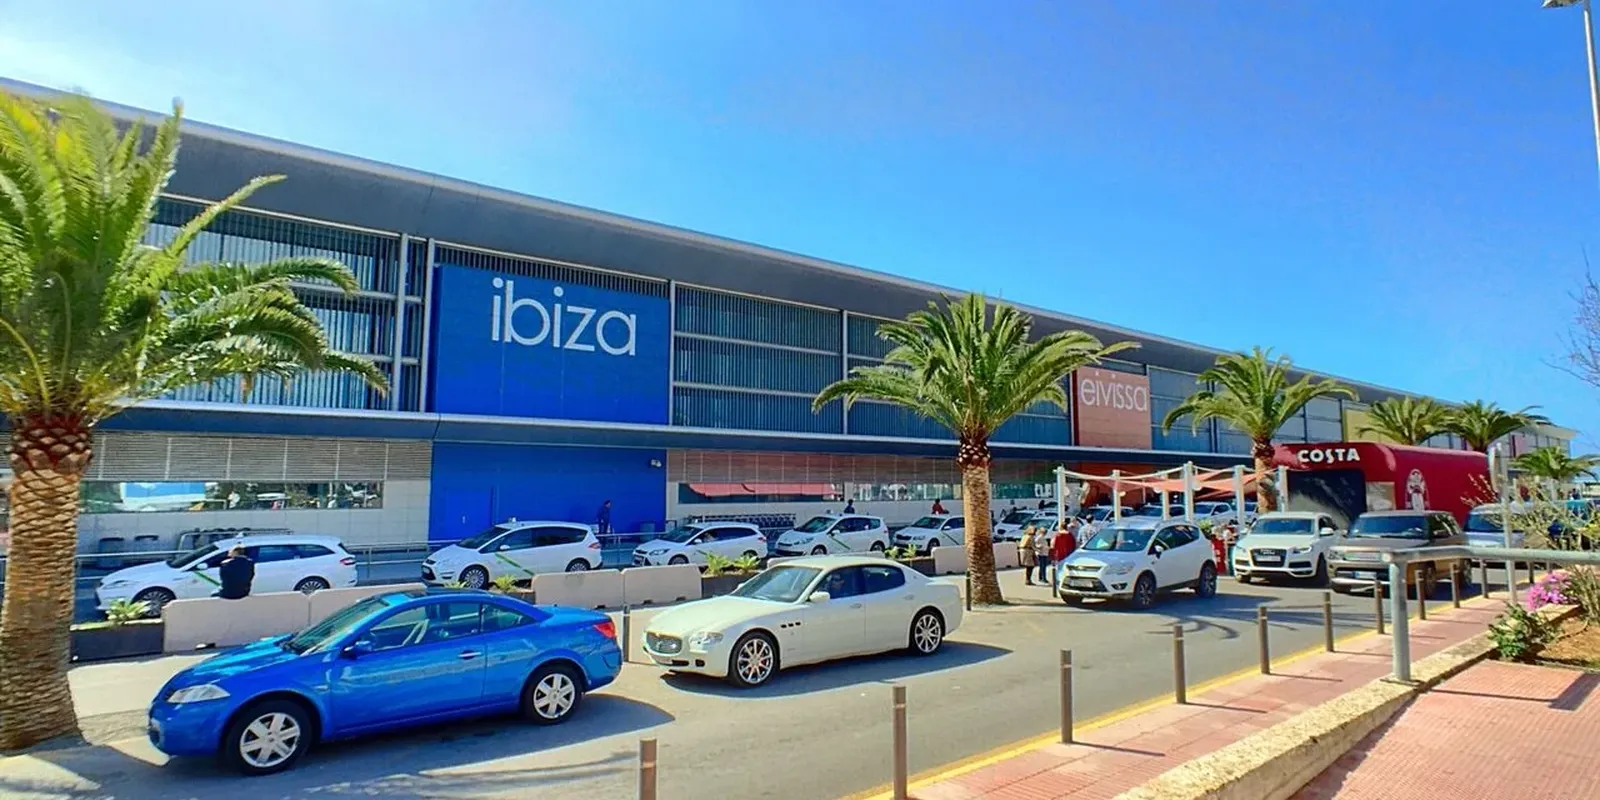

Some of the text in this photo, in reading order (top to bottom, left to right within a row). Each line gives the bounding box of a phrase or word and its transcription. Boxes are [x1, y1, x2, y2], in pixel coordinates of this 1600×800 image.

[491, 277, 636, 356] ibiza
[1080, 370, 1147, 412] eivissa
[1297, 448, 1360, 464] COSTA
